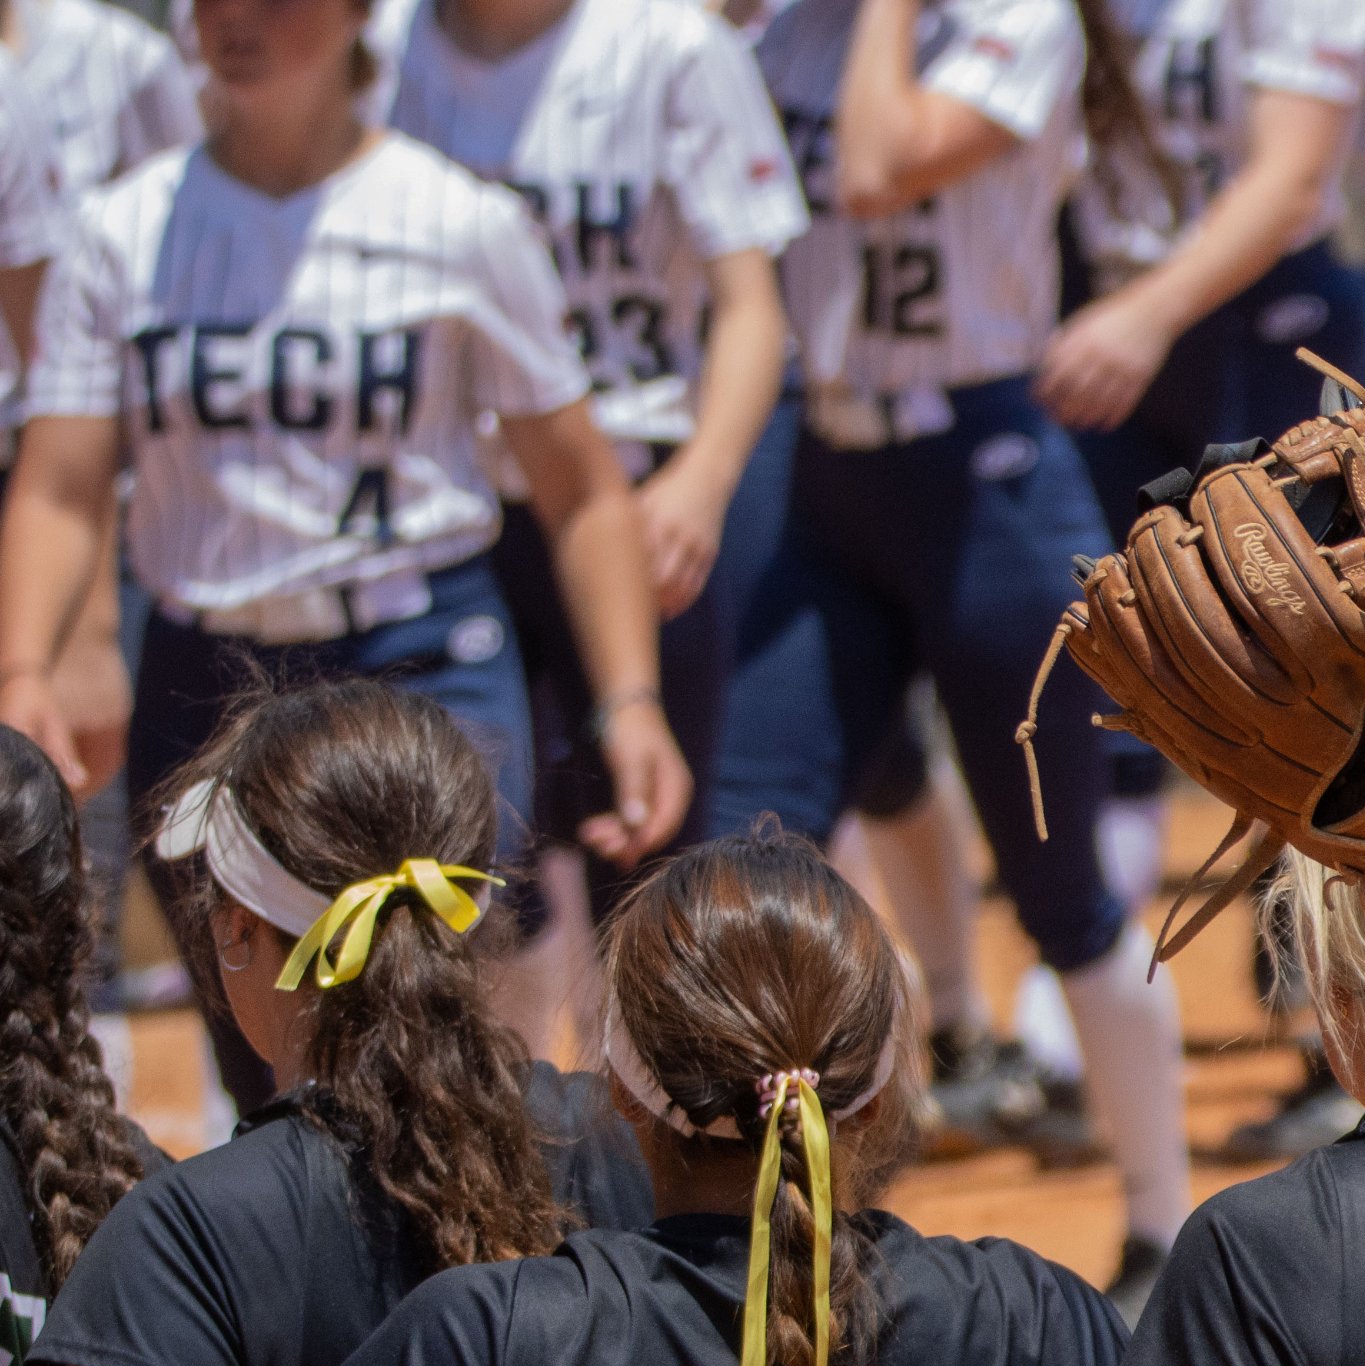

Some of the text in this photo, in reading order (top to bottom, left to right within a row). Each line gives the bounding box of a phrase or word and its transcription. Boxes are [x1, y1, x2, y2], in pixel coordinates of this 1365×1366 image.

[858, 243, 945, 337] 12
[132, 324, 420, 436] TECH
[336, 468, 397, 545] 4
[1233, 522, 1307, 615] Rawlings
